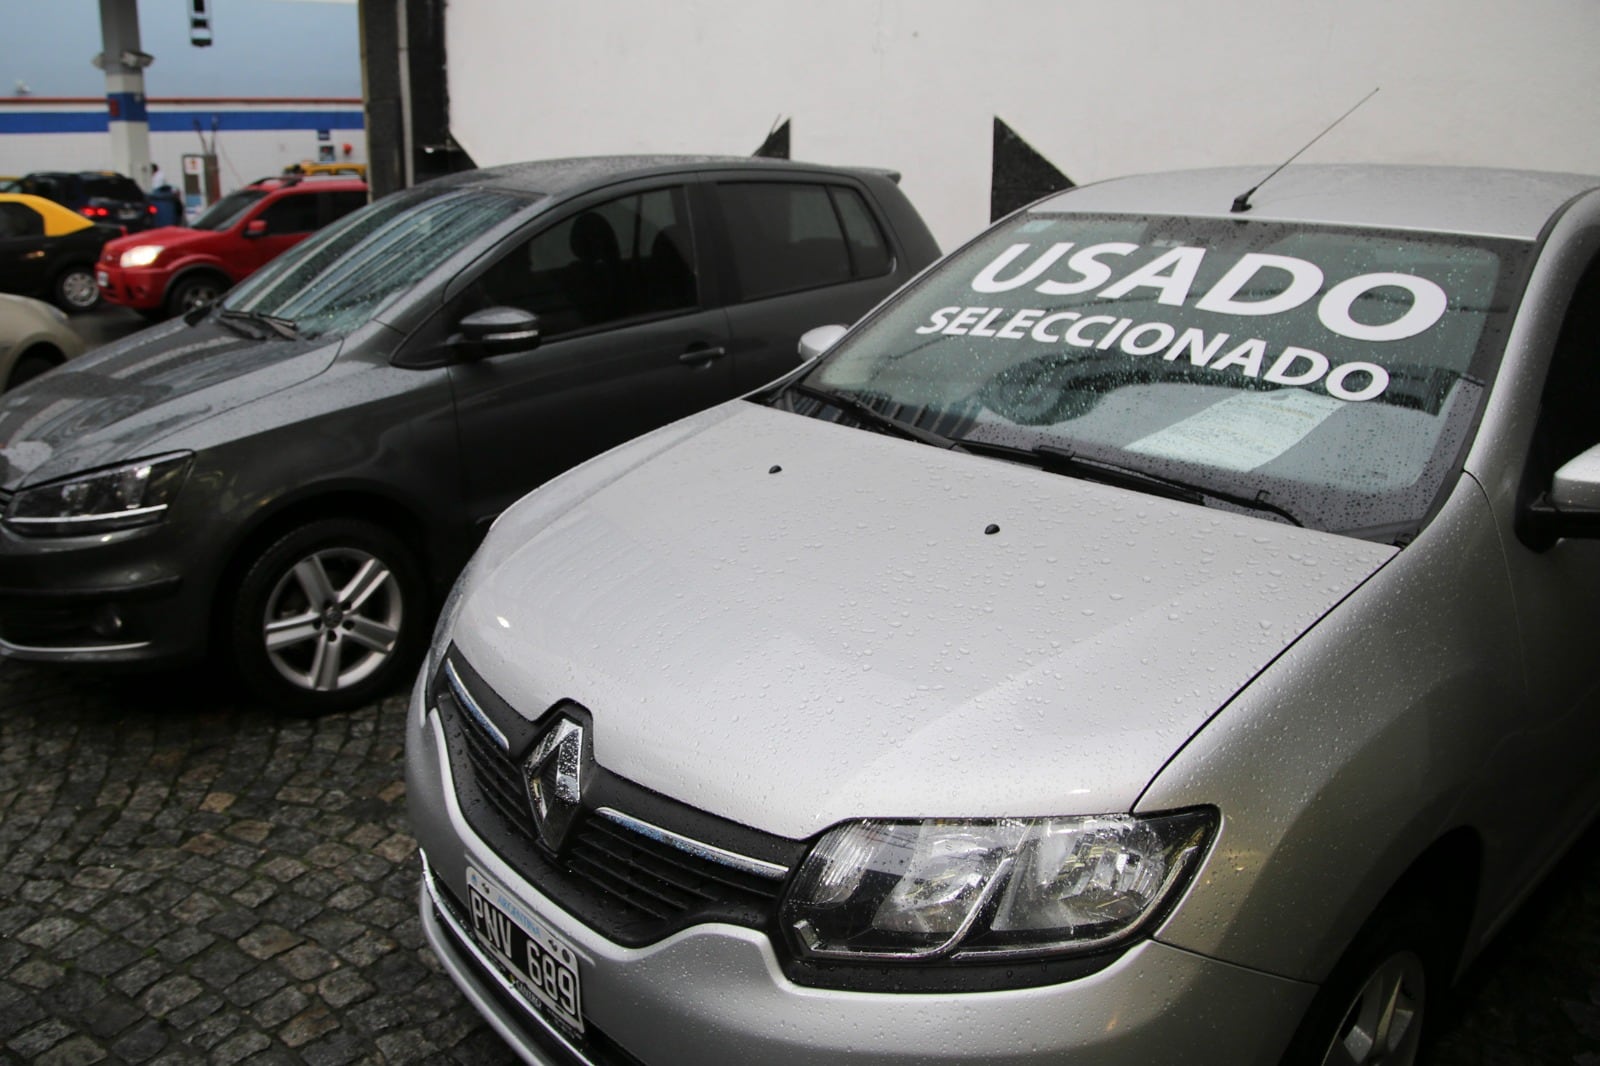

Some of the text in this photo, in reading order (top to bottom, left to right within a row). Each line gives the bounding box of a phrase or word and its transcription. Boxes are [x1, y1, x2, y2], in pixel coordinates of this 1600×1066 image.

[971, 242, 1447, 341] USADO
[915, 306, 1389, 401] SELECCIONADO
[471, 889, 512, 959] PNV
[526, 939, 576, 1016] 689
